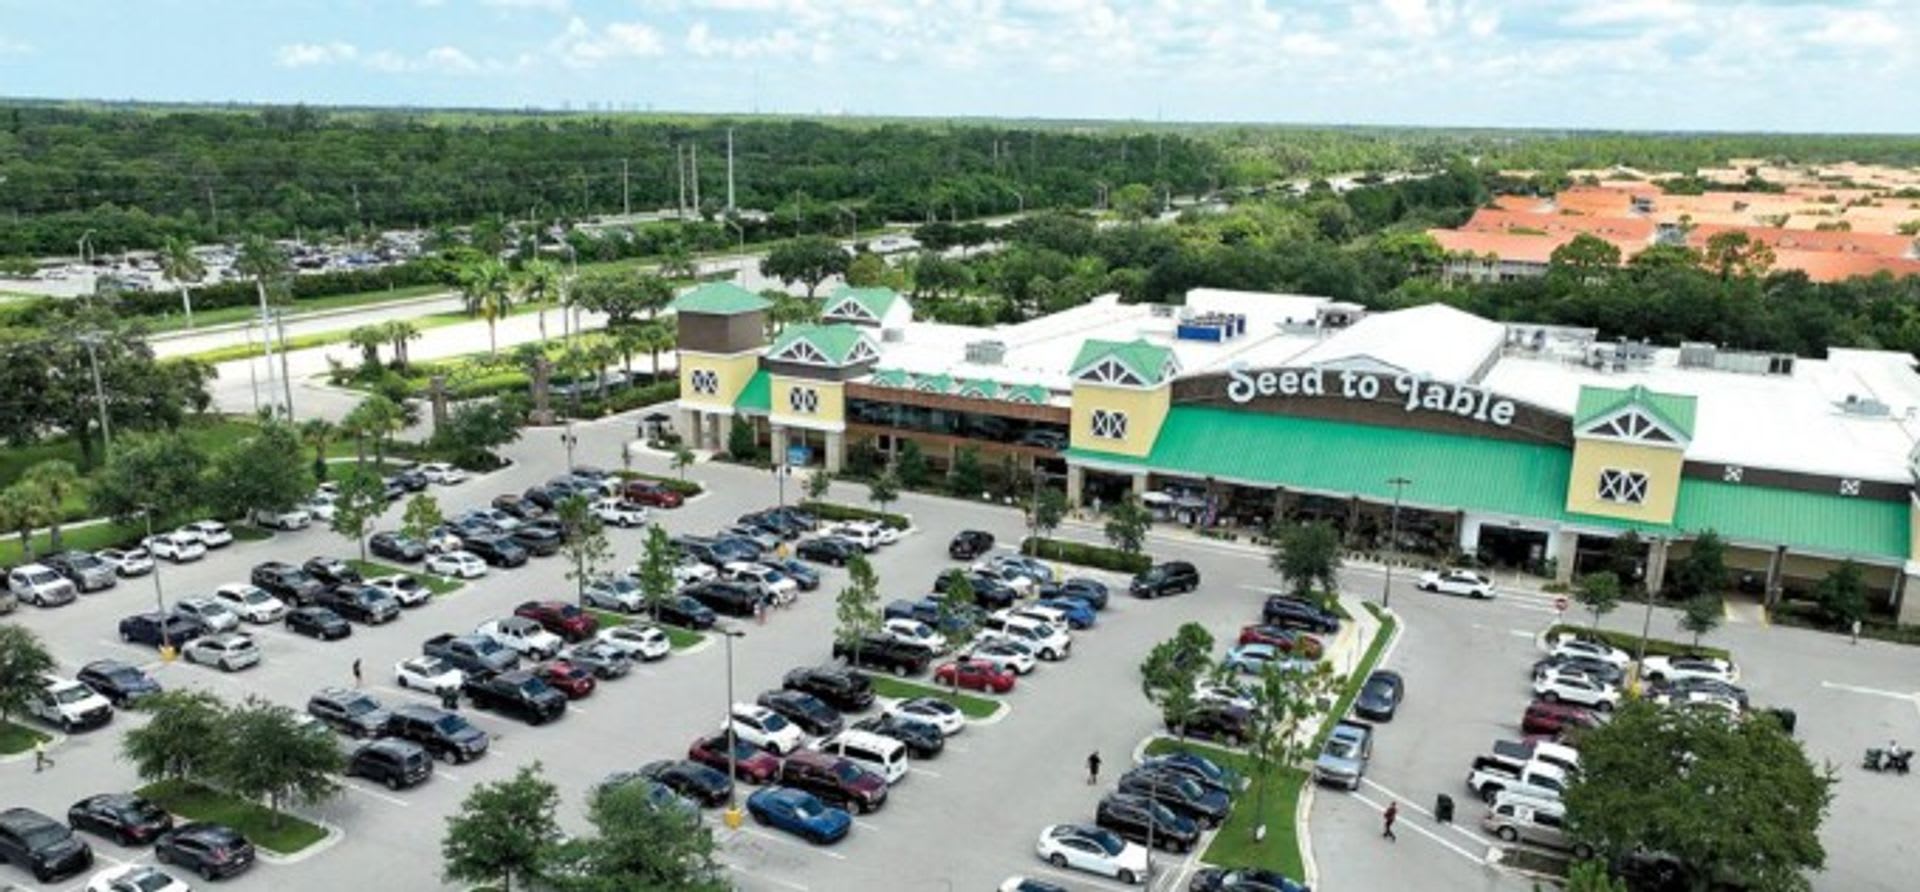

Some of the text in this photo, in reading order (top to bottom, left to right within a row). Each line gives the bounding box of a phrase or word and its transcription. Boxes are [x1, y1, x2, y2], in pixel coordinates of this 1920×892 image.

[1227, 361, 1516, 426] Seed to Table
